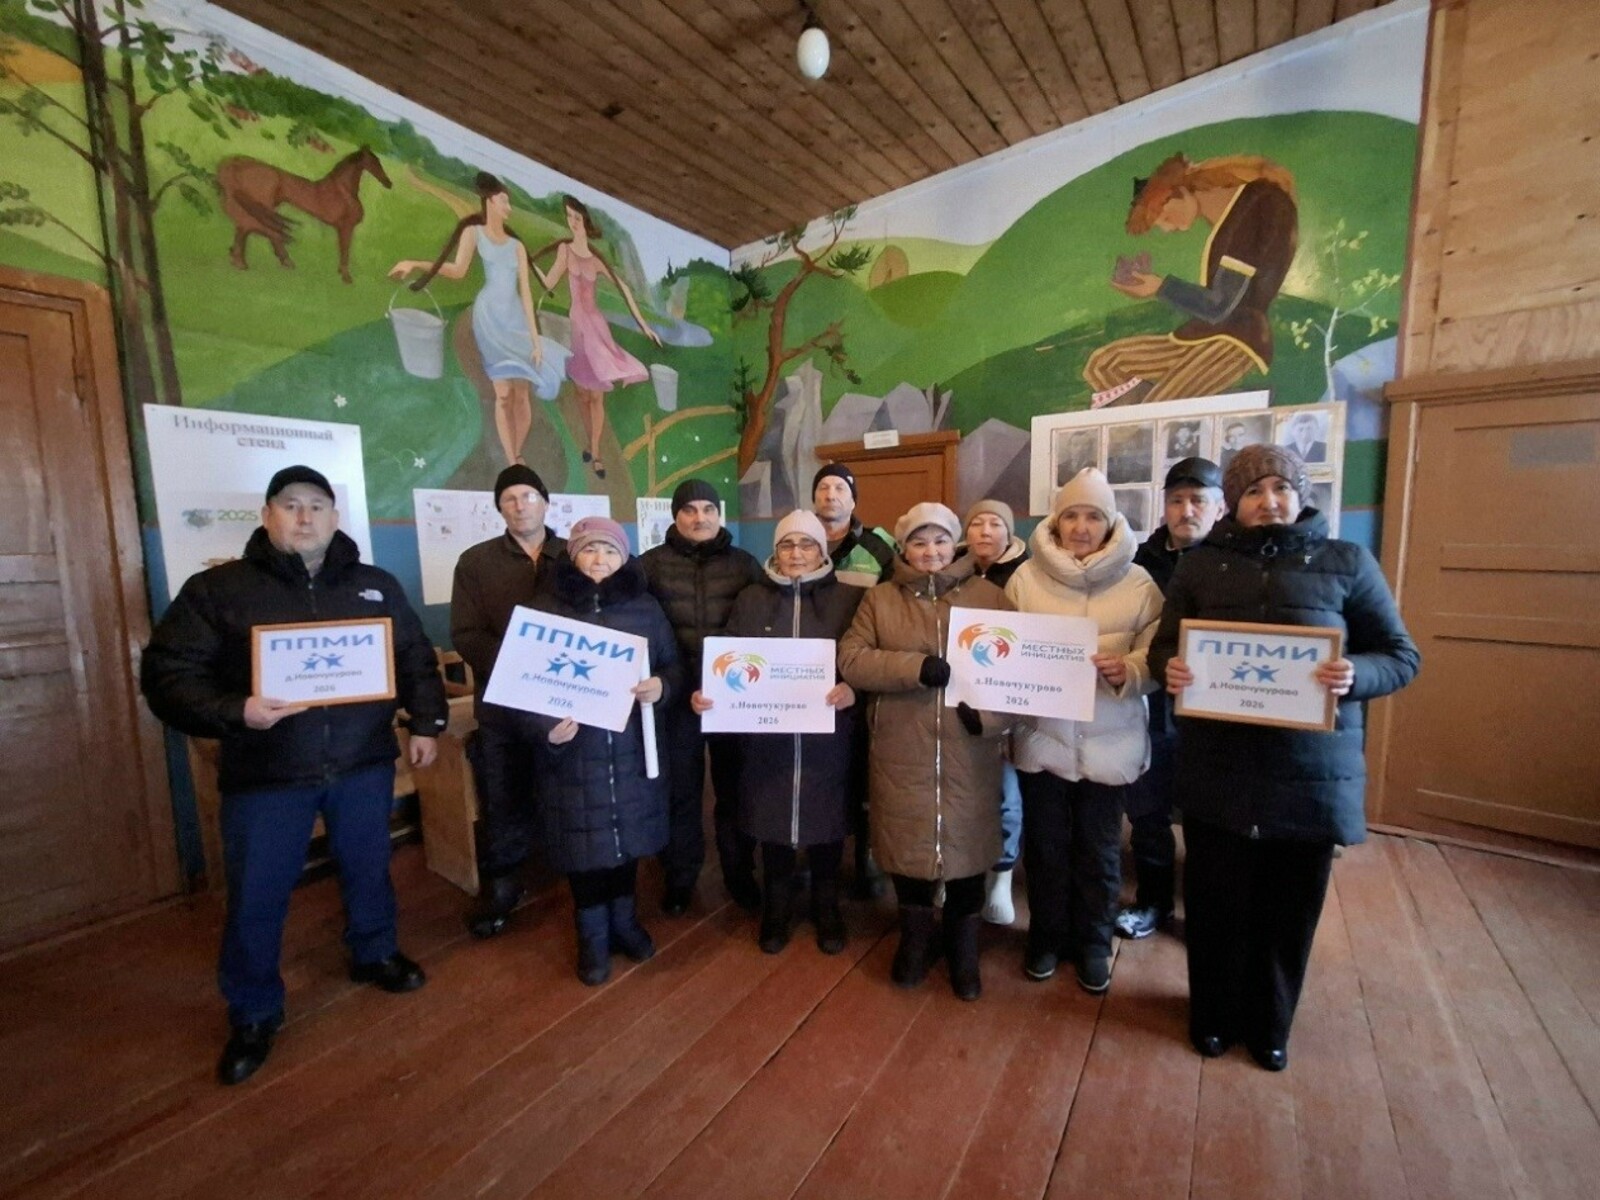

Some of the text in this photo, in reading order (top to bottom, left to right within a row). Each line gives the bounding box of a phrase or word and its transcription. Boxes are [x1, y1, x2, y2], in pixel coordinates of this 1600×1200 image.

[217, 508, 259, 521] 2025
[270, 633, 374, 651] ППМИ
[518, 621, 635, 663] ППМИ
[1020, 650, 1085, 662] ИНИЦИАТИВ
[1021, 643, 1085, 656] МЕСТНЫХ
[1197, 639, 1318, 662] ППМИ
[547, 696, 574, 709] 2026
[1005, 695, 1030, 706] 2026
[1240, 699, 1265, 709] 2026
[758, 716, 779, 725] 2026
